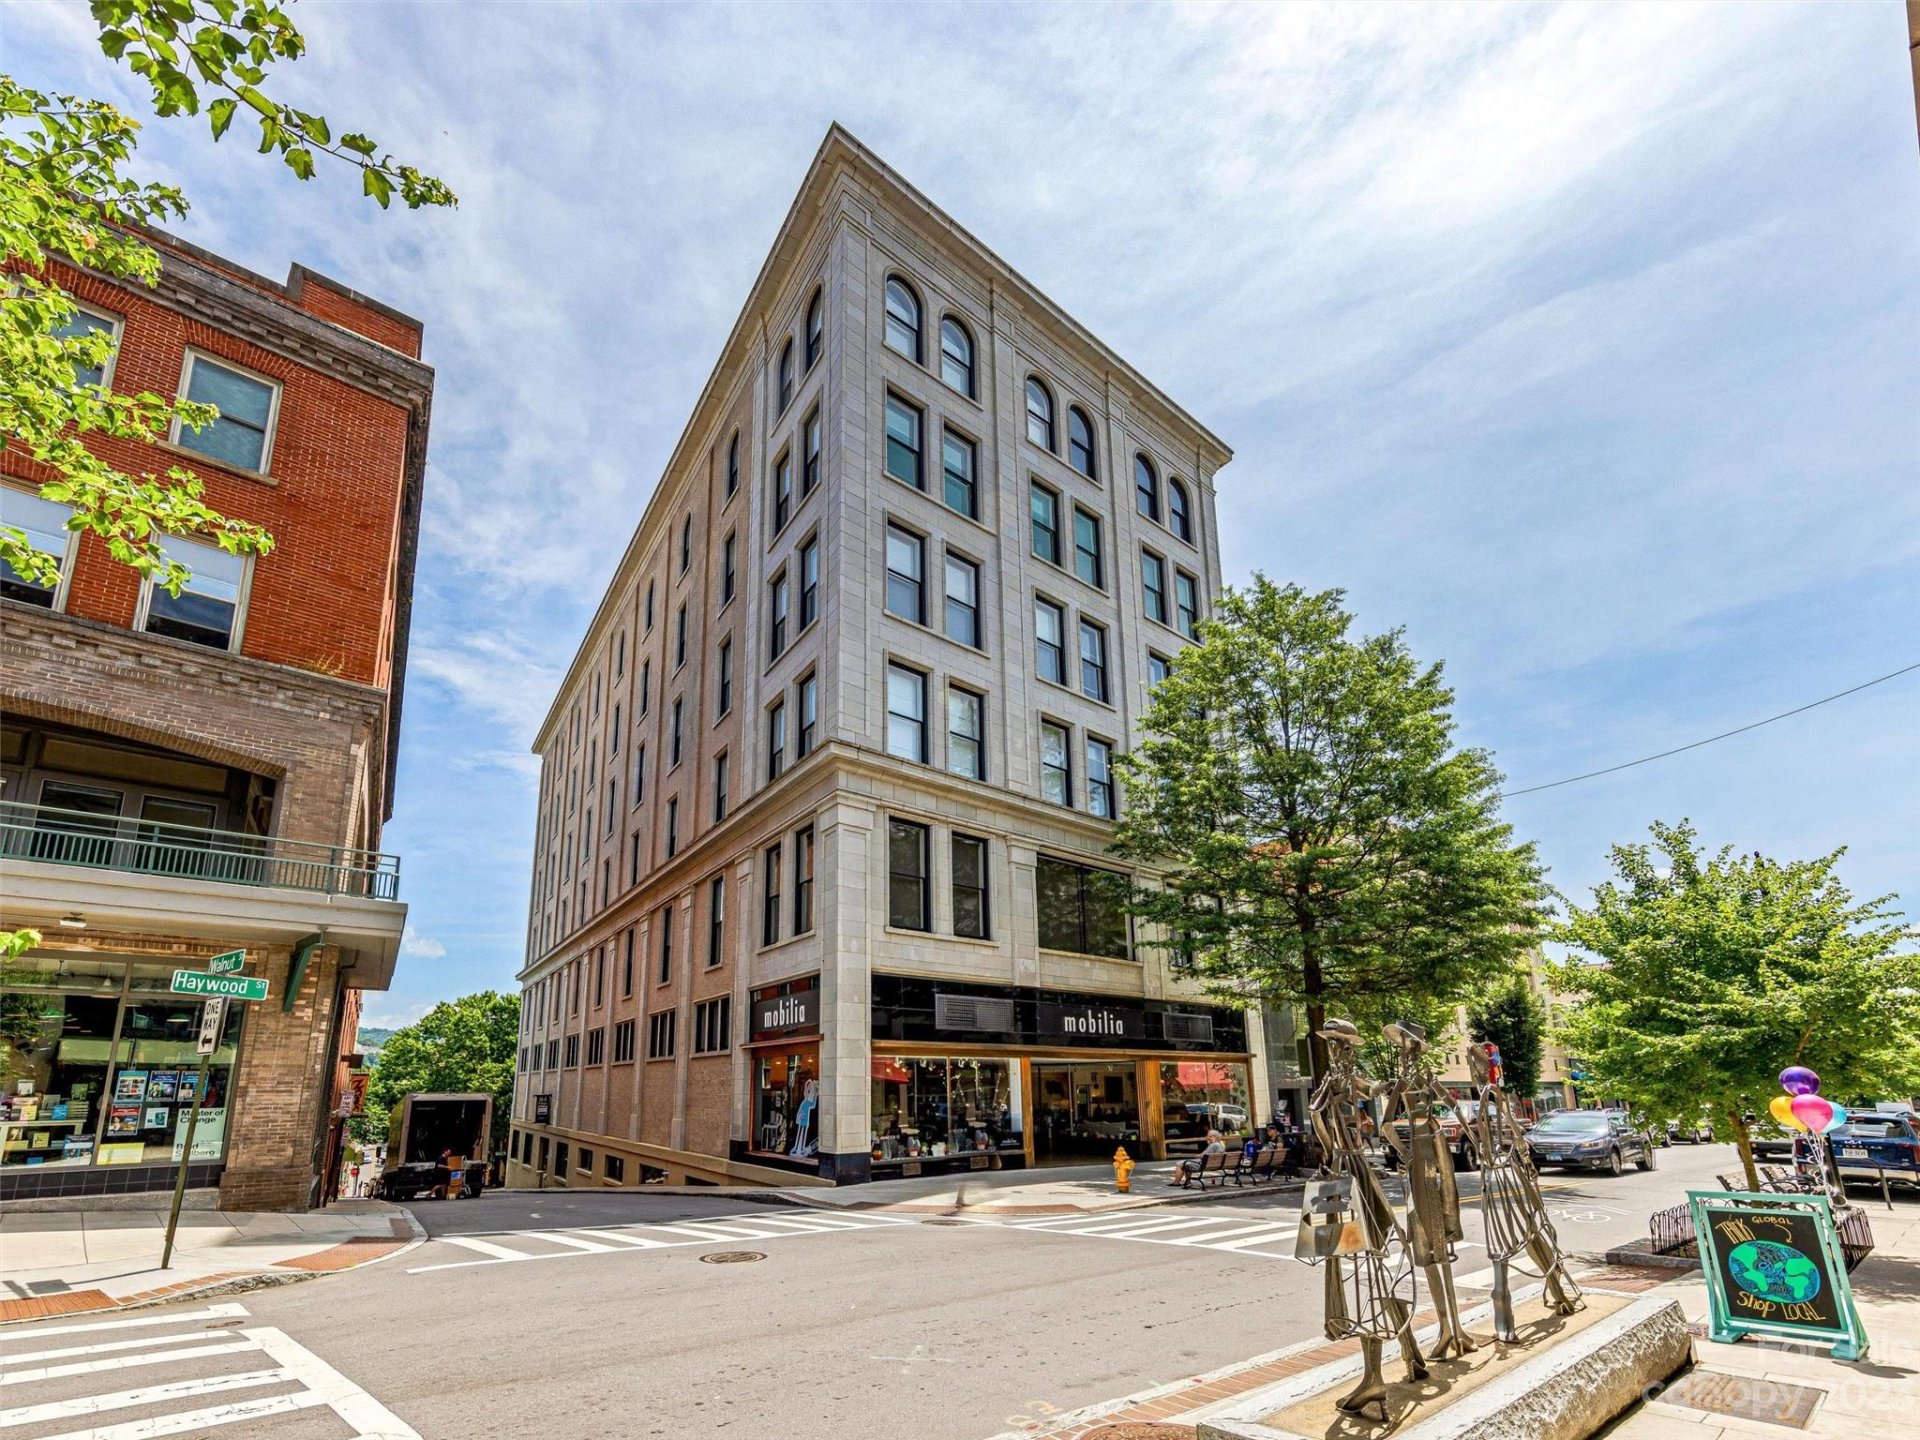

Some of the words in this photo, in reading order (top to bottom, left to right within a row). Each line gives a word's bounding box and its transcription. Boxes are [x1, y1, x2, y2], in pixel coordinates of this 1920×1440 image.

[208, 955, 235, 973] Walnut
[175, 973, 248, 994] Haywood
[206, 1001, 220, 1015] ONE
[764, 997, 806, 1028] mobilia
[203, 1017, 217, 1031] WAY
[1064, 1009, 1124, 1035] mobilia
[215, 1109, 224, 1117] of
[1736, 1290, 1777, 1318] Shop
[1780, 1301, 1827, 1321] LOCAL
